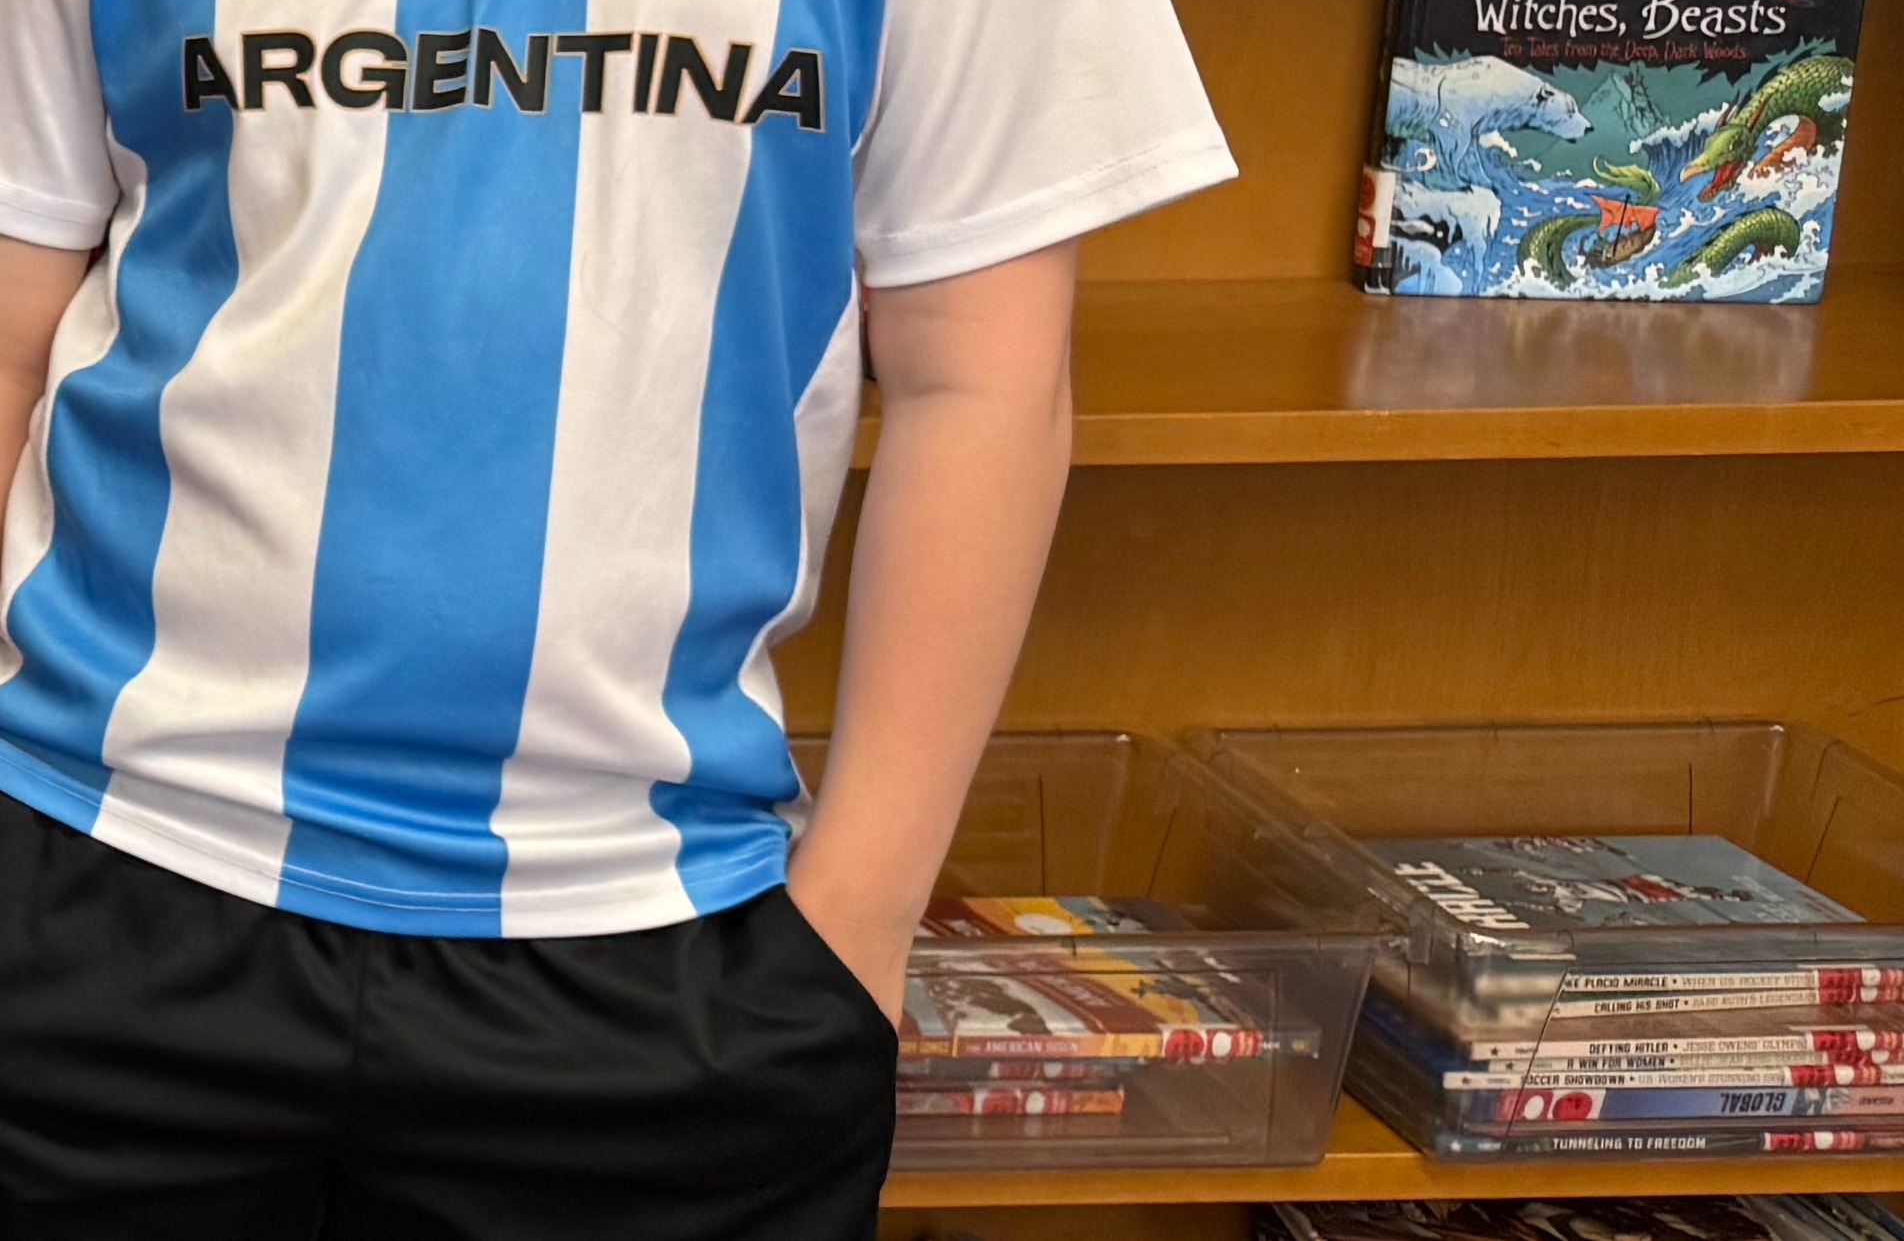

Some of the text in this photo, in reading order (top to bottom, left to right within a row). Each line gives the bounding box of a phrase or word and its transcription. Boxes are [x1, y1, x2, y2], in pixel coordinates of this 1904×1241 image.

[1527, 38, 1560, 57] Tales
[183, 26, 825, 133] ARGENTINA
[1622, 974, 1668, 989] MIRACLE
[1594, 997, 1681, 1014] CALLING SHOT
[1588, 1041, 1670, 1055] DEFYING HITLER
[1578, 1056, 1666, 1070] WIN FOR WOMEN
[1564, 1073, 1625, 1086] SHOWDOWN
[1719, 1091, 1787, 1114] GLOBAL
[1552, 1135, 1707, 1150] TUNNELING TO FREEDOM
